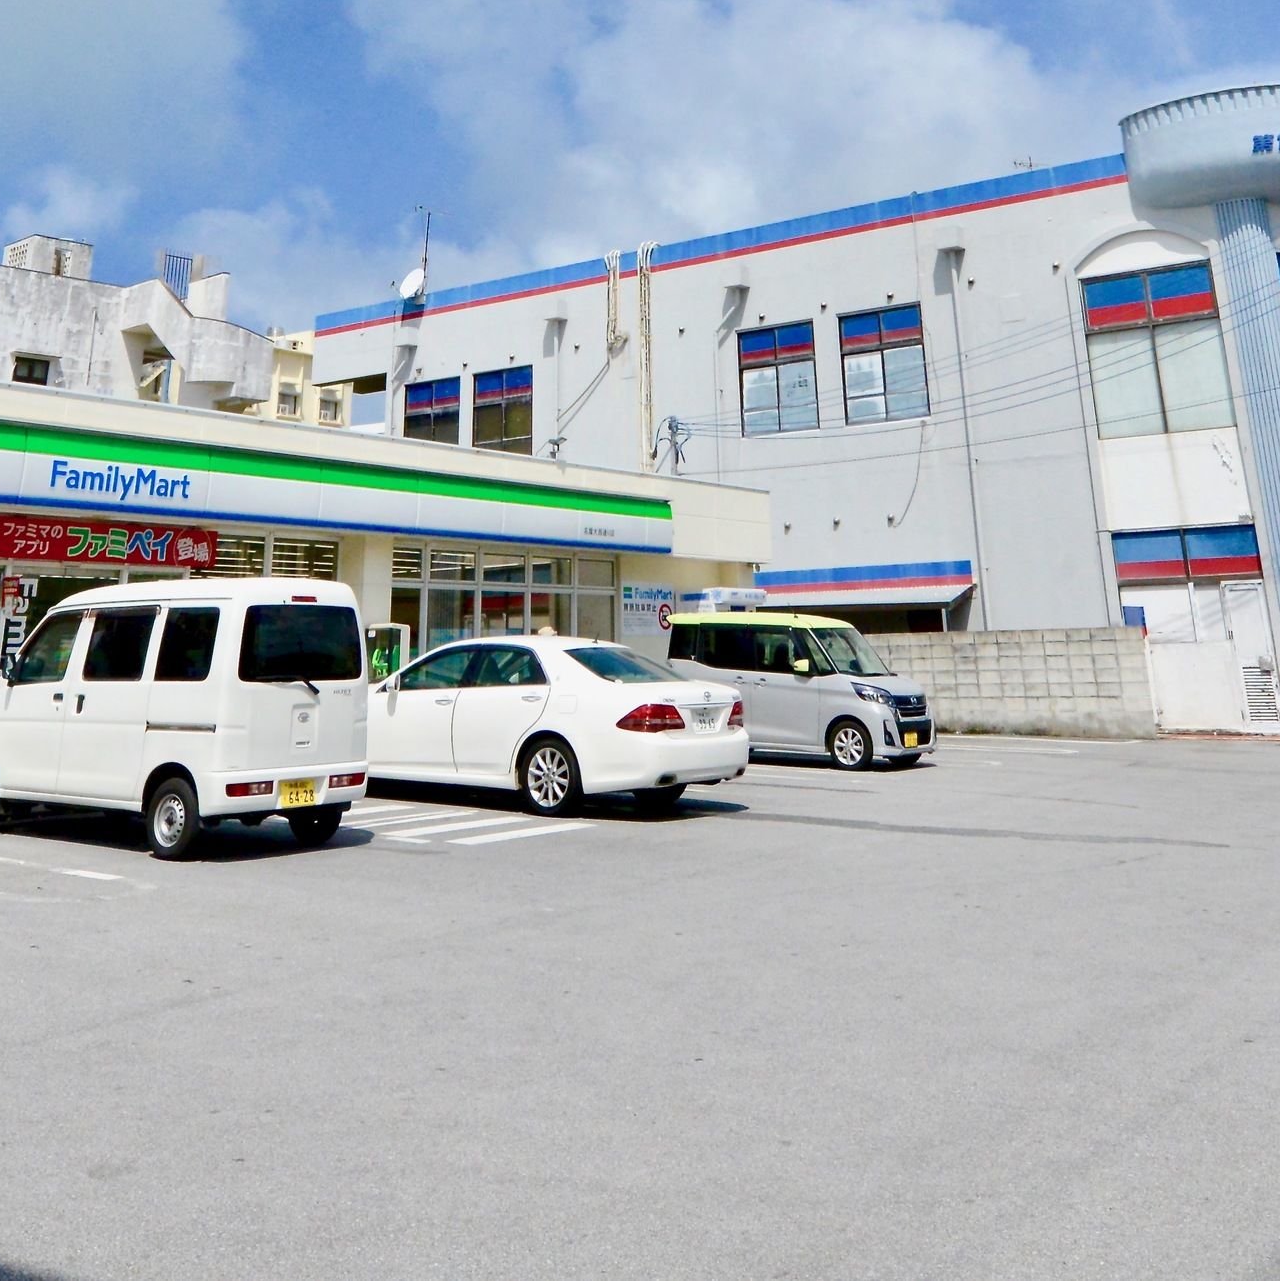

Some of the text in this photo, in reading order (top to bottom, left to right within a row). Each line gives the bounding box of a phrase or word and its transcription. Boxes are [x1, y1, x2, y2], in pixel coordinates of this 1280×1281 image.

[50, 460, 191, 500] FamilyMart
[2, 522, 64, 539] ファミマの
[12, 539, 50, 555] アプリ
[66, 526, 174, 561] ファミペイ
[176, 537, 211, 562] 登場
[634, 587, 673, 601] FamilyMart
